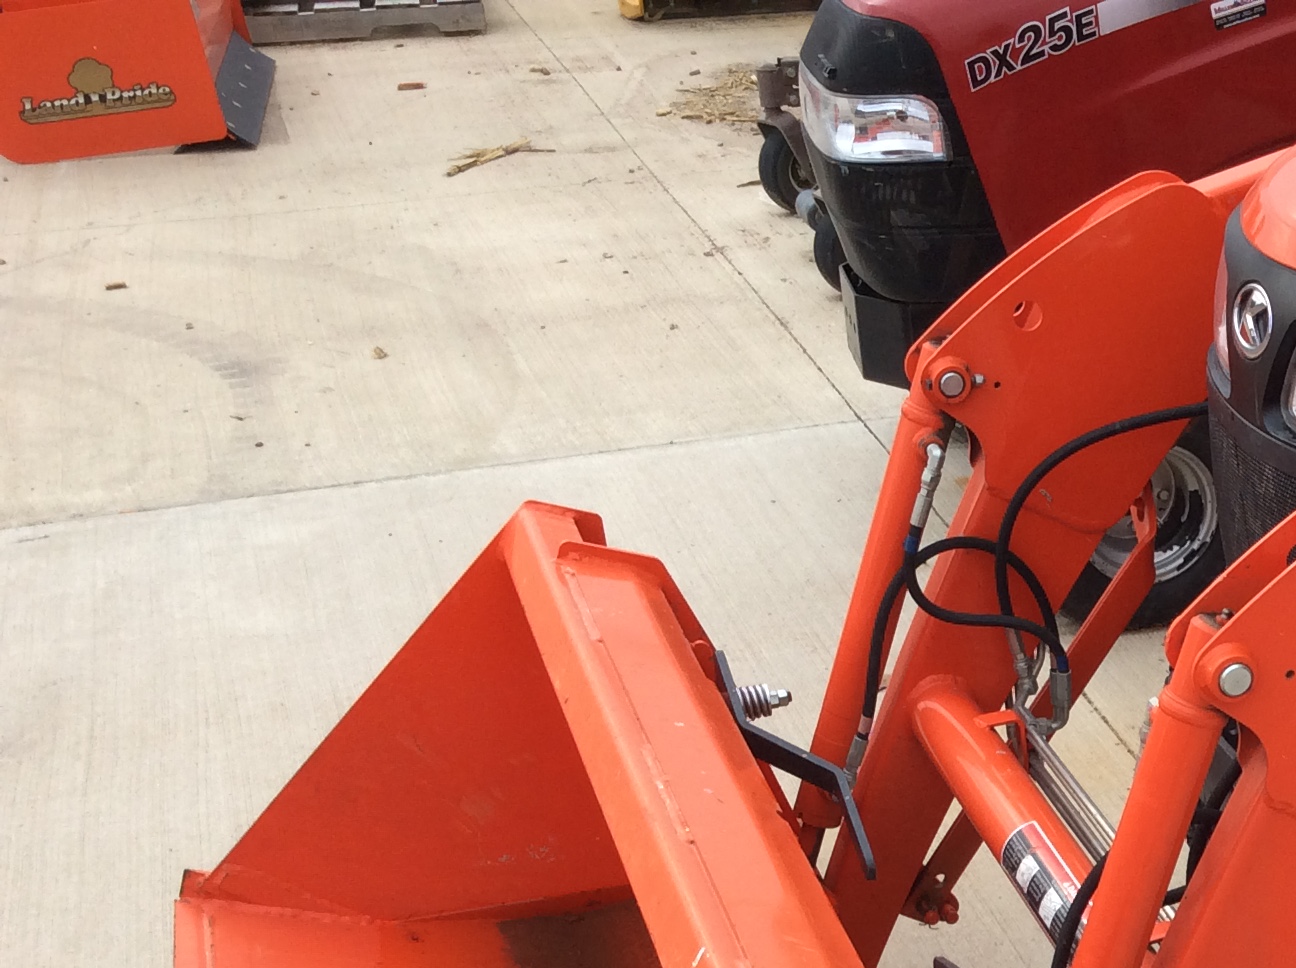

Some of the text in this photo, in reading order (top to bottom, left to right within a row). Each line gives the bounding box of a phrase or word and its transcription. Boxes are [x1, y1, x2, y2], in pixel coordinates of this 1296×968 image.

[965, 6, 1099, 92] DX25E
[21, 82, 173, 118] Land Pride
